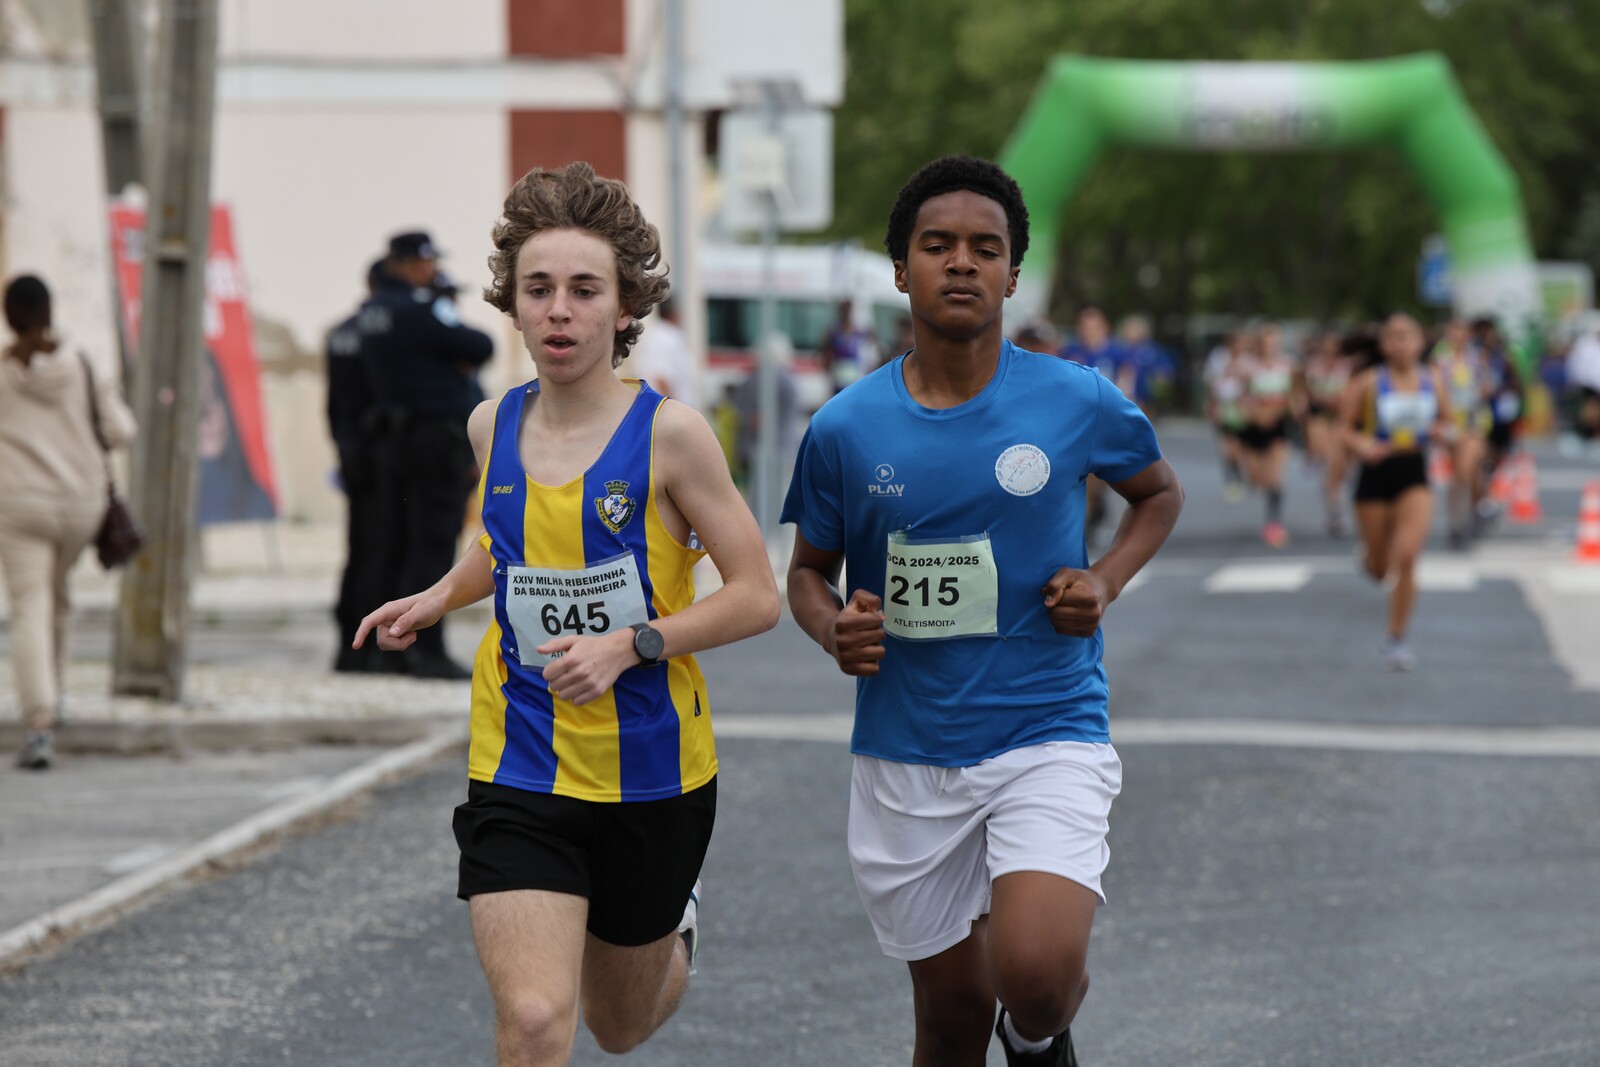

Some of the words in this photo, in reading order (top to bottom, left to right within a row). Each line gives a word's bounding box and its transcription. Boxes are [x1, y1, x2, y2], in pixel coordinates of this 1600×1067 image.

[868, 484, 905, 497] PLAY
[910, 556, 980, 567] 2024/2025
[512, 575, 534, 585] XXIV
[536, 576, 563, 587] MILHA
[565, 567, 626, 587] RIBEIRINHA
[514, 587, 527, 596] DA
[529, 587, 557, 597] BAIXA
[559, 588, 571, 598] DA
[573, 579, 627, 598] BANHEIRA
[890, 575, 960, 607] 215
[540, 600, 610, 636] 645
[893, 617, 956, 628] ATLETISMOITA
